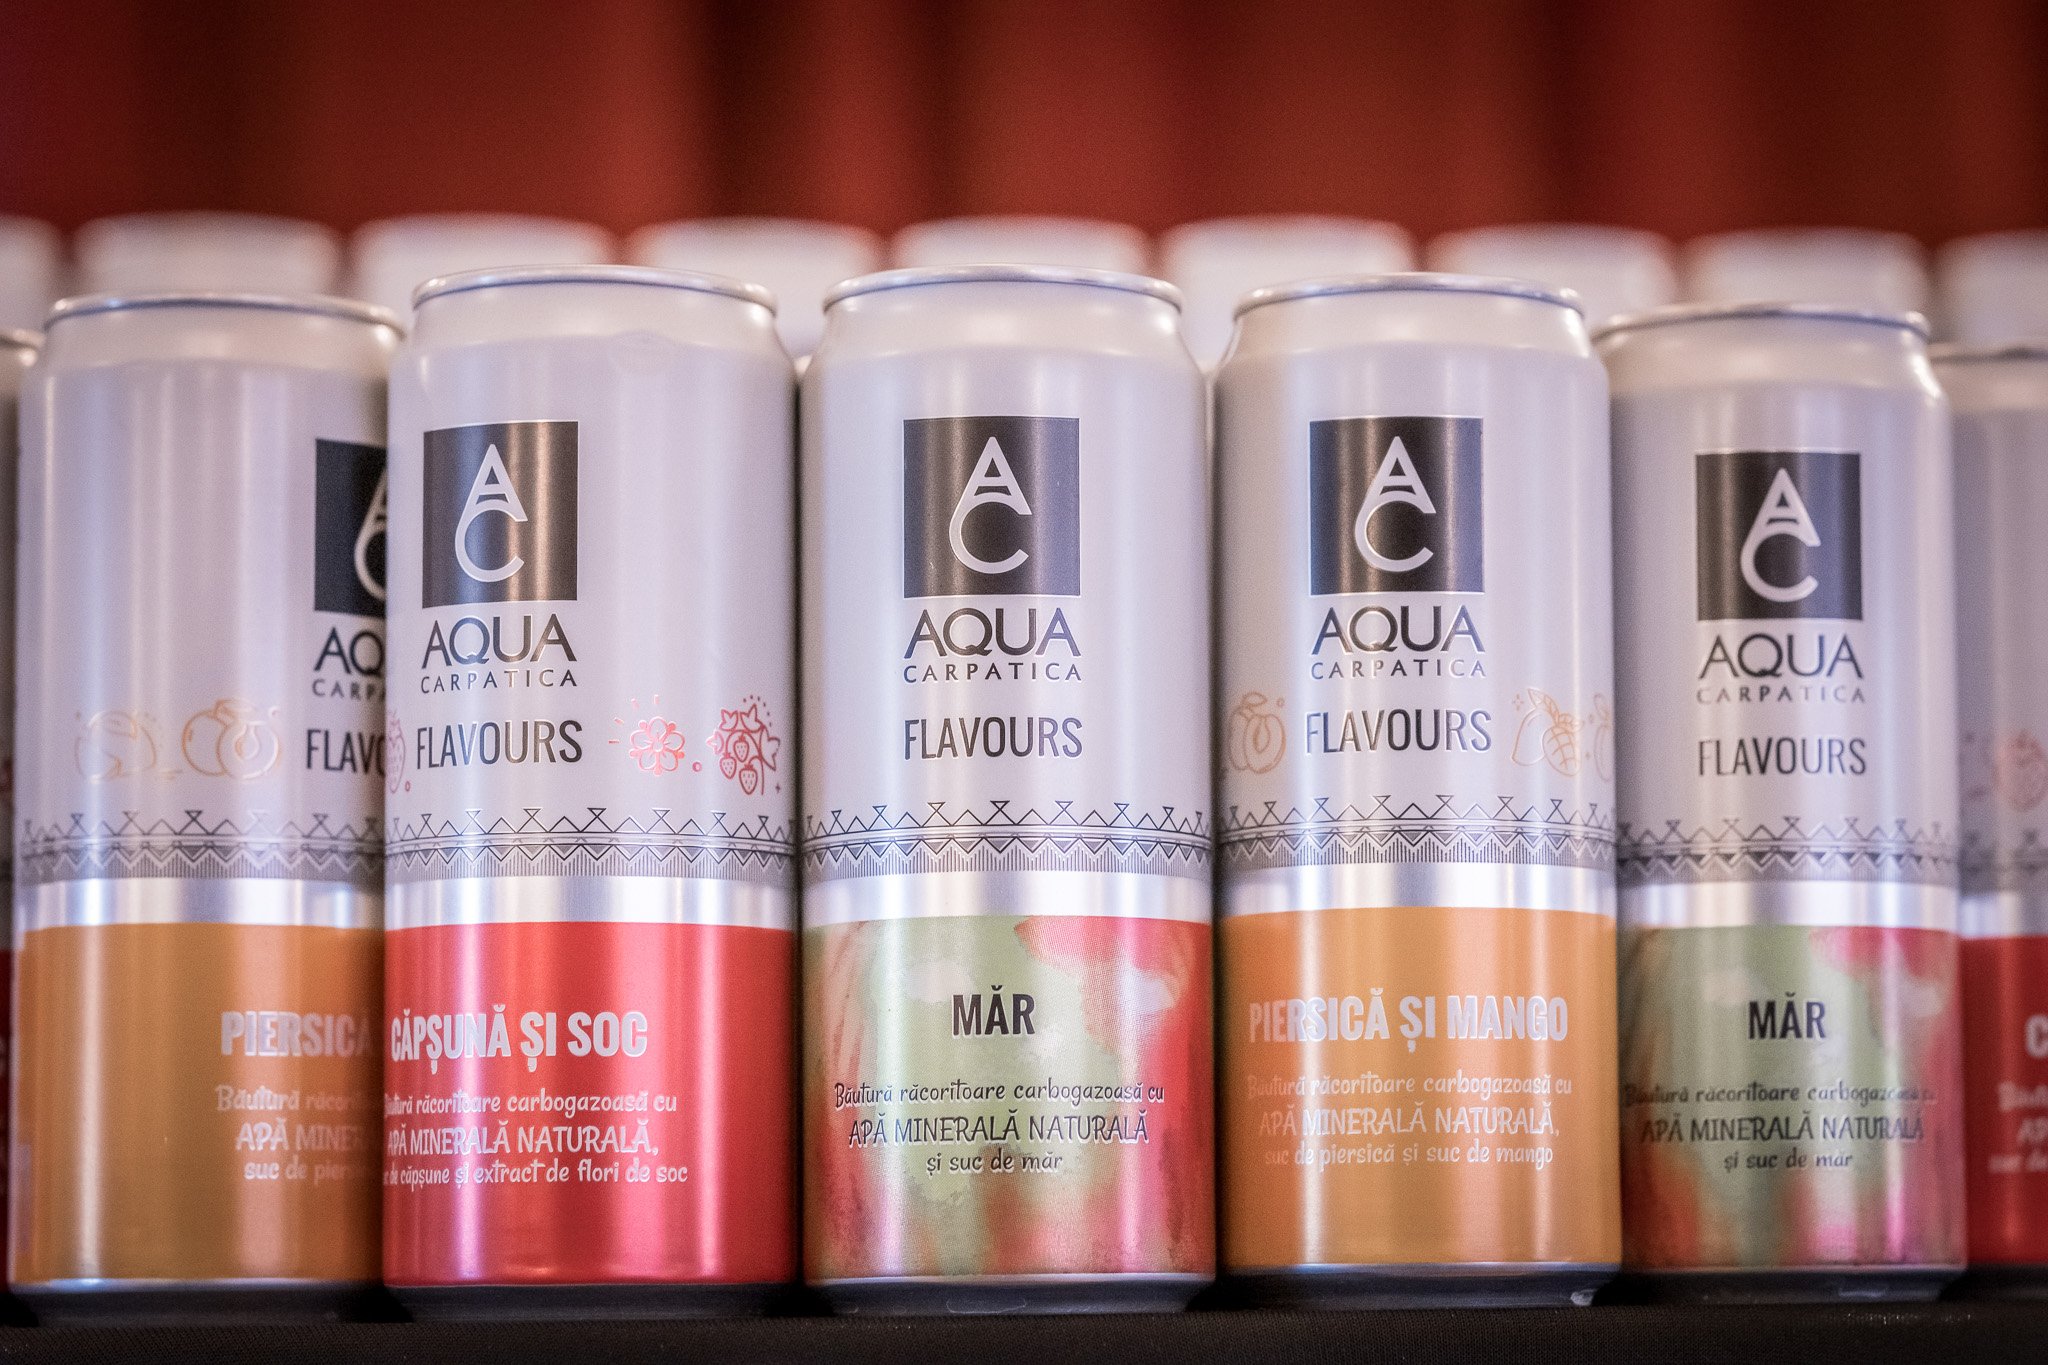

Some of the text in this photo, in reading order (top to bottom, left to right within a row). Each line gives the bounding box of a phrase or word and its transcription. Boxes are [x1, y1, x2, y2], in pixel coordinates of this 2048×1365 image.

[421, 613, 578, 669] AQUA
[904, 608, 1081, 659] AQUA
[1311, 605, 1485, 655] AQUA
[903, 662, 1081, 683] CARPATICA
[1311, 659, 1486, 680] CARPATICA
[1698, 633, 1863, 679] AQUA
[421, 669, 578, 693] CARPATICA
[1697, 685, 1865, 705] CARPATICA
[417, 720, 582, 769] FLAVOURS
[904, 716, 1082, 760] FLAVOURS
[1306, 709, 1492, 754] FLAVOURS
[1698, 737, 1866, 776] FLAVOURS
[953, 985, 1035, 1036] MĂR
[1249, 988, 1568, 1053] PIERSICĂ ȘI MANGO
[1748, 992, 1826, 1039] MĂR
[391, 1004, 648, 1074] CĂPȘUNĂ ȘI SOC
[416, 1089, 501, 1114] răcoritoare
[507, 1088, 648, 1118] carbogazoasă
[653, 1094, 677, 1111] cu
[835, 1077, 1164, 1108] Băutură răcoritoare carbogazoasă cu
[1311, 1071, 1415, 1096] răcoritoare
[1423, 1070, 1551, 1100] carbogazoasă
[1555, 1079, 1572, 1094] cu
[236, 1117, 290, 1151] APĂ
[849, 1109, 1149, 1146] APĂ MINERALĂ NATURALĂ
[1259, 1101, 1560, 1137] APĂ MINERALĂ NATURALĂ,
[1641, 1113, 1683, 1143] APĂ
[1690, 1110, 1814, 1142] MINERALĂ
[387, 1119, 659, 1157] APĂ MINERALĂ NATURALĂ,
[1265, 1138, 1553, 1173] suc de piersică și suc de mango
[244, 1161, 280, 1180] suc
[285, 1154, 308, 1180] de
[400, 1165, 450, 1192] căpșune
[455, 1161, 470, 1190] și
[475, 1159, 545, 1184] extract
[546, 1158, 569, 1183] de
[577, 1158, 619, 1183] flori
[626, 1157, 650, 1183] de
[656, 1165, 688, 1183] soc
[926, 1148, 1062, 1176] și suc de măr
[1746, 1154, 1777, 1169] suc
[1786, 1147, 1807, 1168] de
